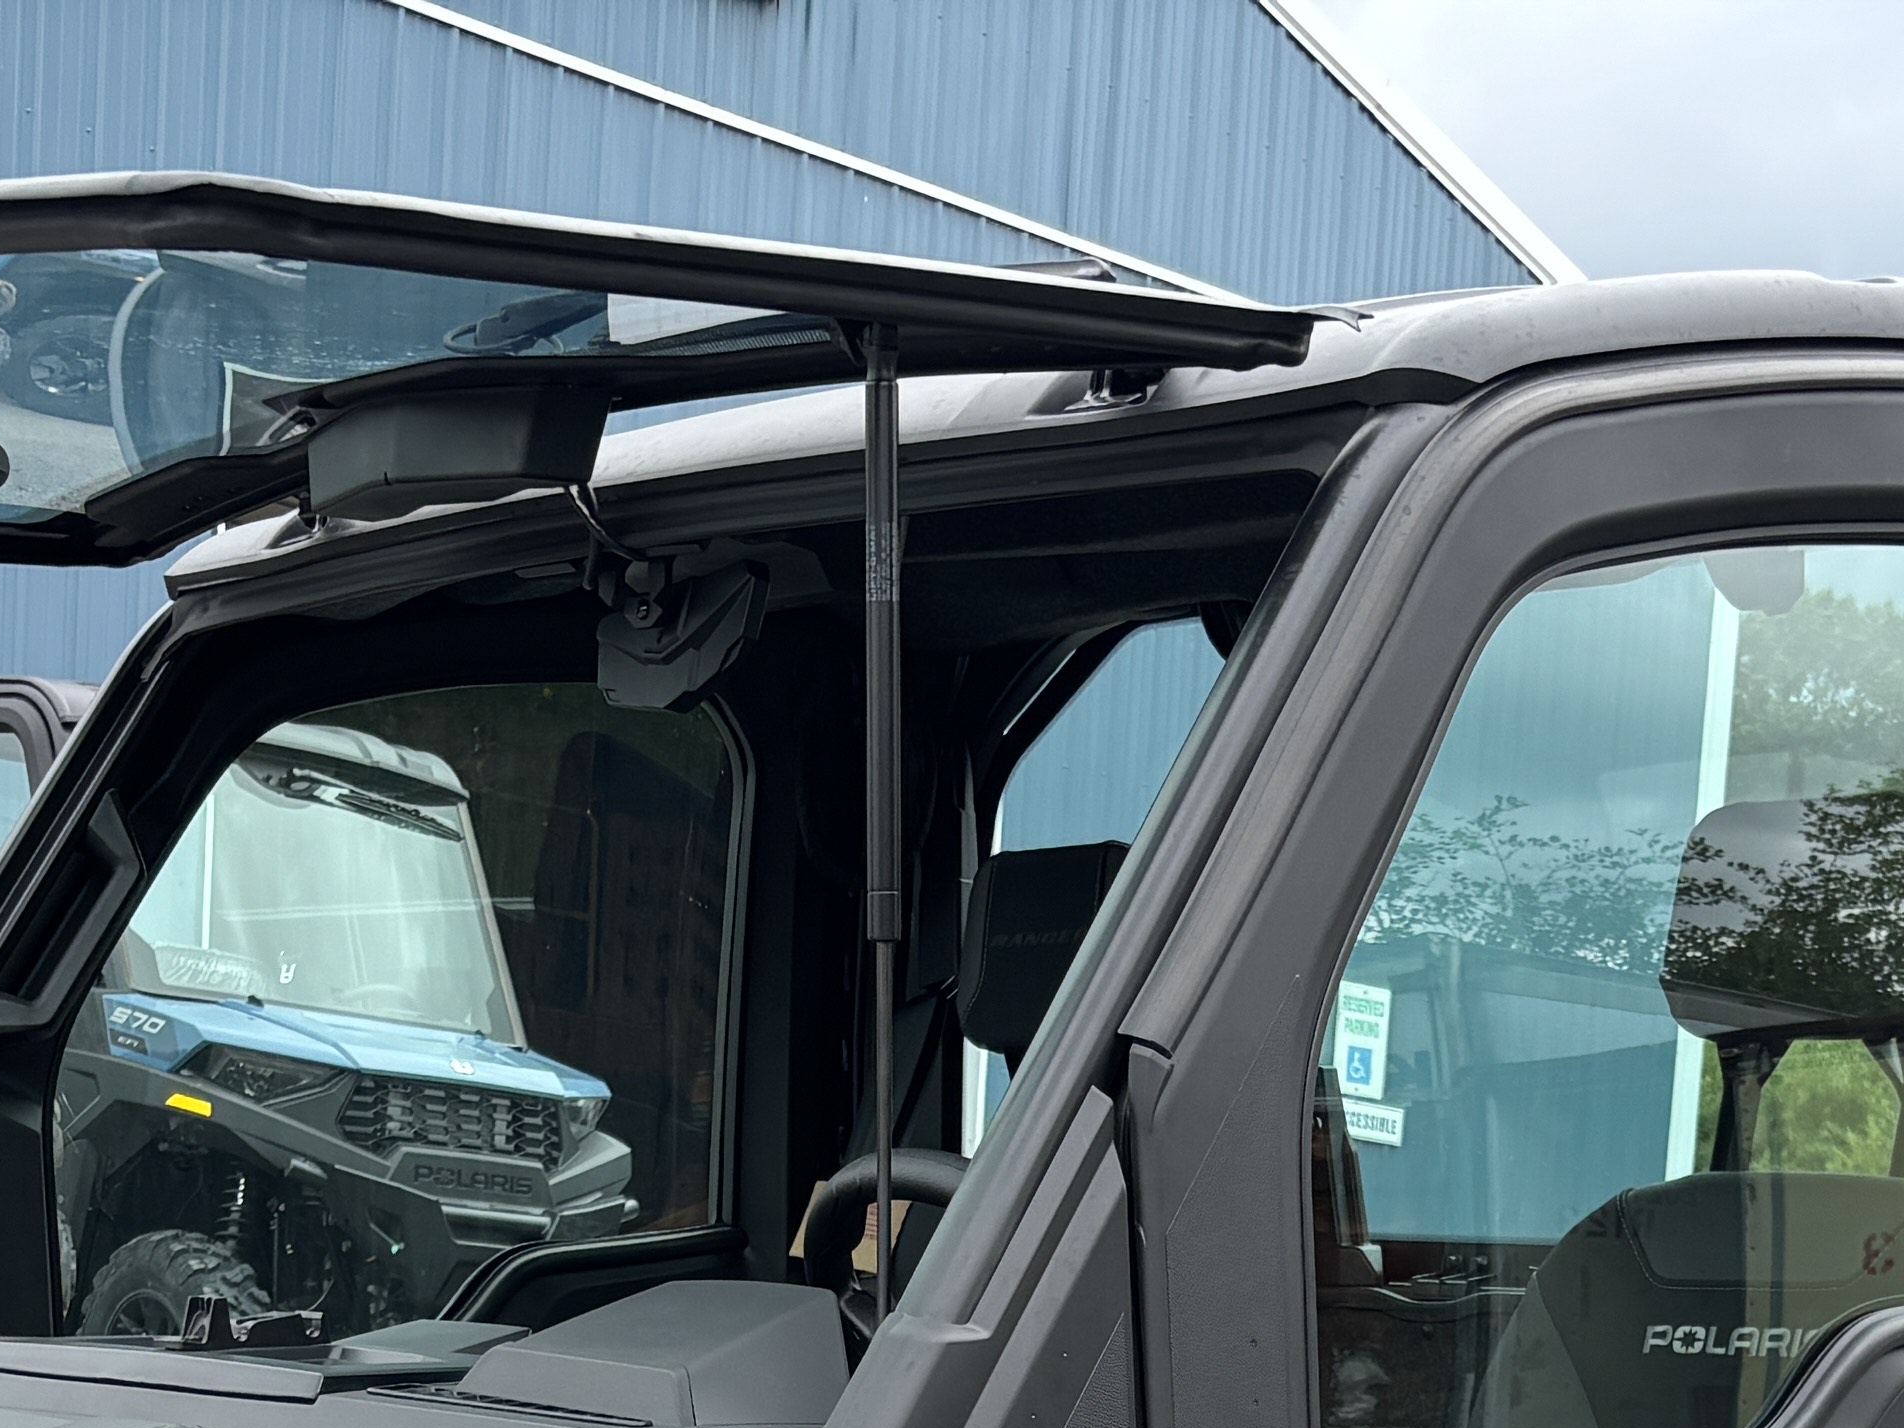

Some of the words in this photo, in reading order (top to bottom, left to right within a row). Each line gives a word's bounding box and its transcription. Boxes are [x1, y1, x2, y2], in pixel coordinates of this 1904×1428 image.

[109, 1006, 166, 1034] 570
[117, 1035, 139, 1048] EFI
[413, 1164, 534, 1195] POLARIS
